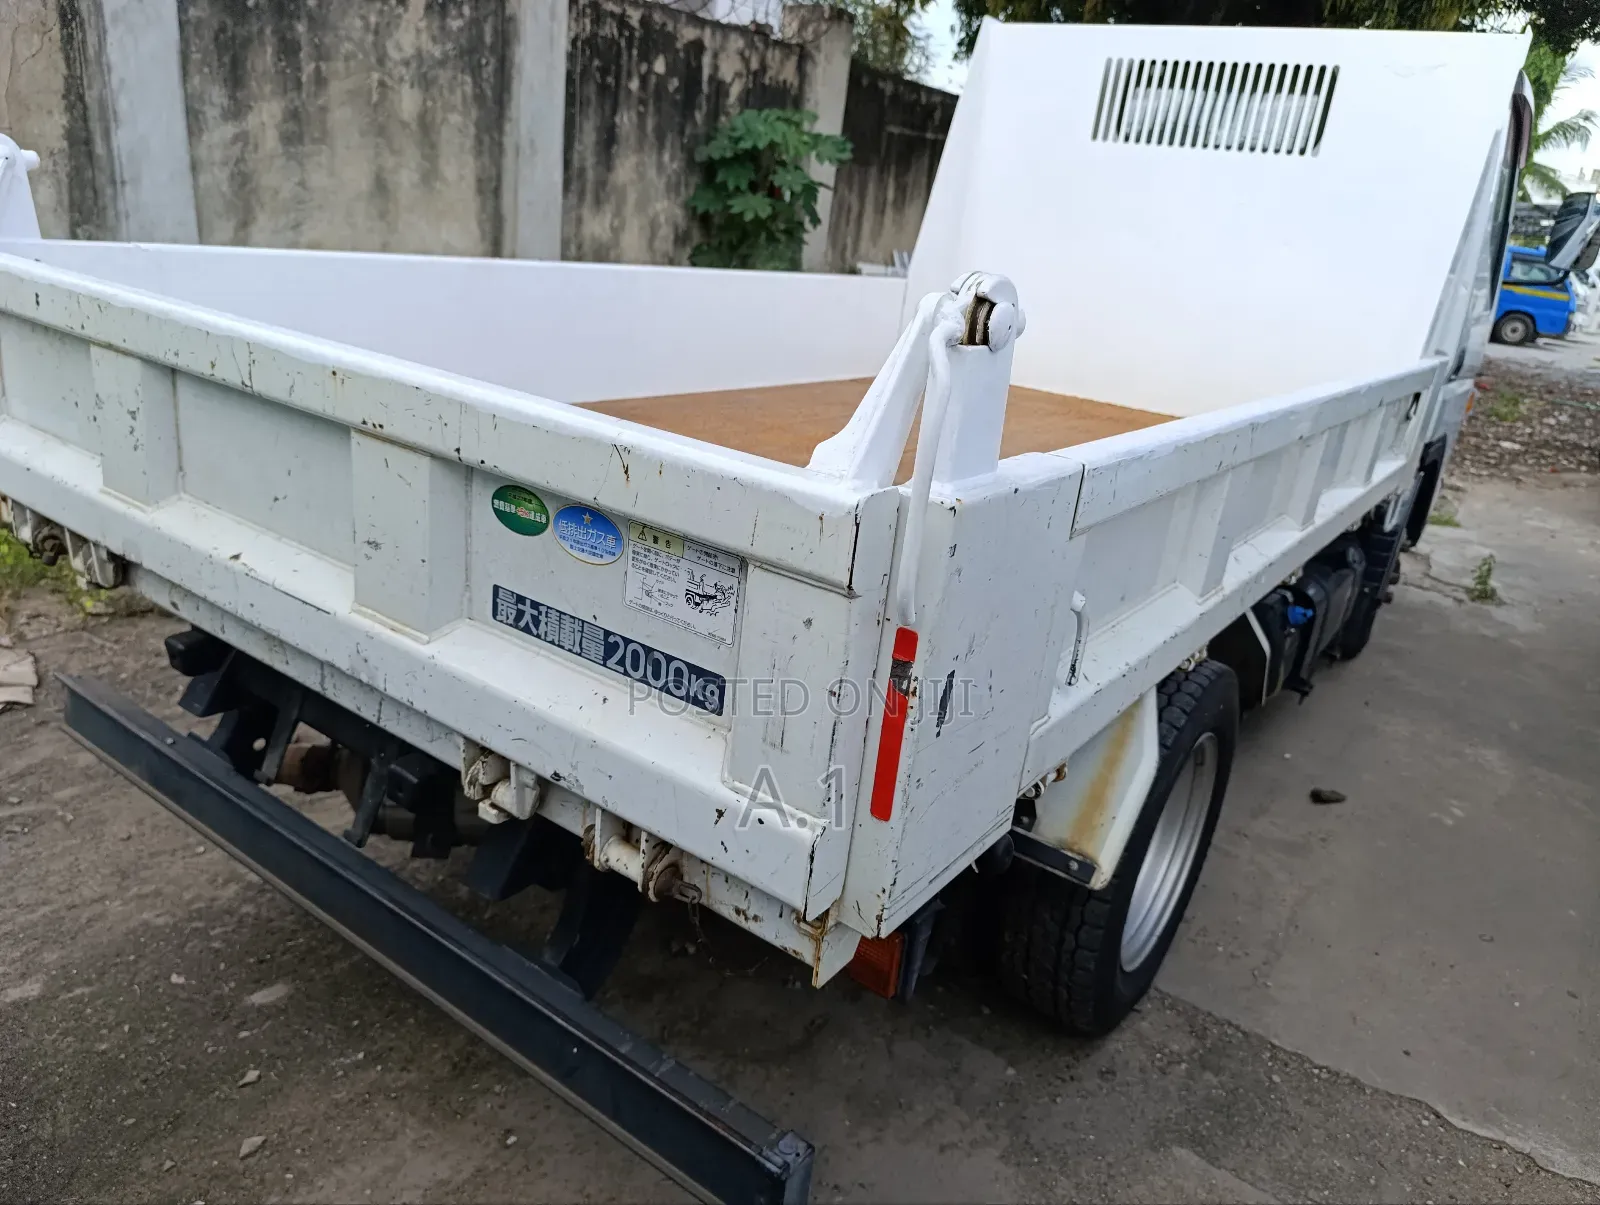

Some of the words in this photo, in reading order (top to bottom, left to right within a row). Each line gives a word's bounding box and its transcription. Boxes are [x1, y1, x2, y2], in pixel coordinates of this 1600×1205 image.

[558, 519, 617, 549] 低排出ガス車
